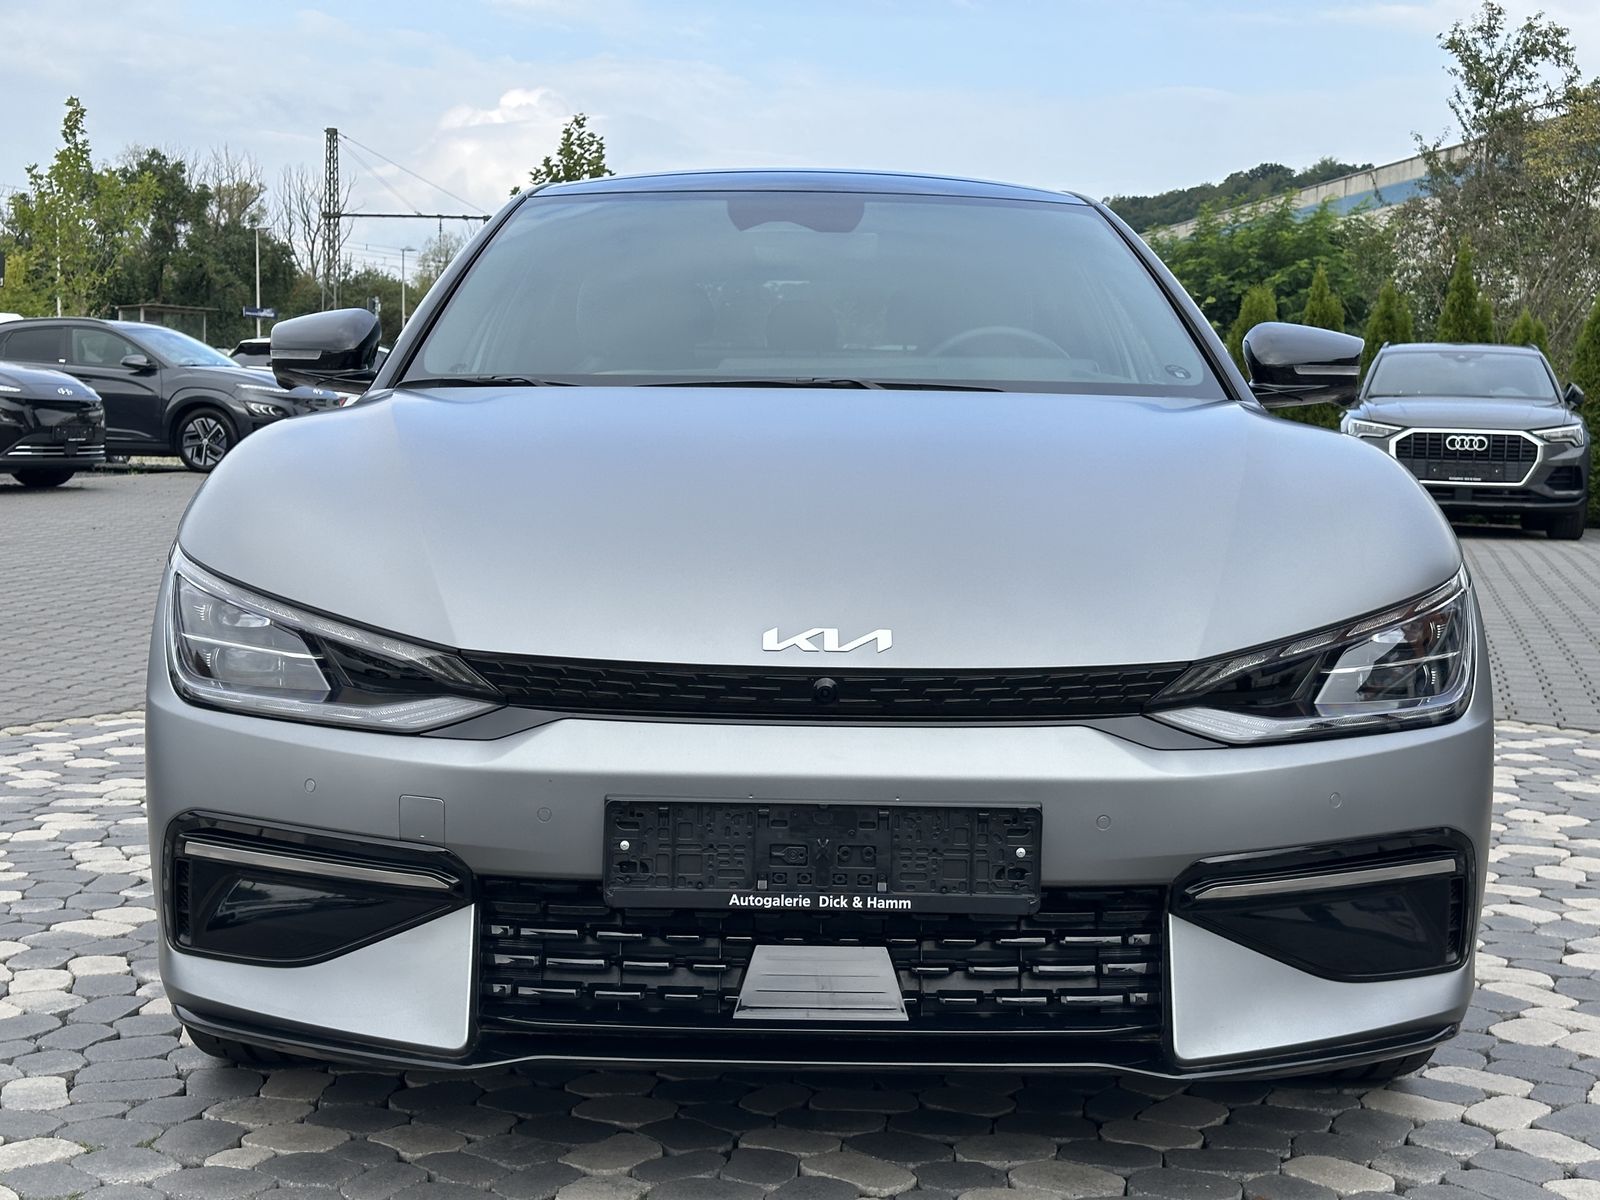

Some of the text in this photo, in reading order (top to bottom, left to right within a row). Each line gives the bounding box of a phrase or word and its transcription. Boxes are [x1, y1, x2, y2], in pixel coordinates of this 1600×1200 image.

[762, 627, 893, 653] KIA
[728, 894, 912, 909] Autogalerie Dick & Hamm
